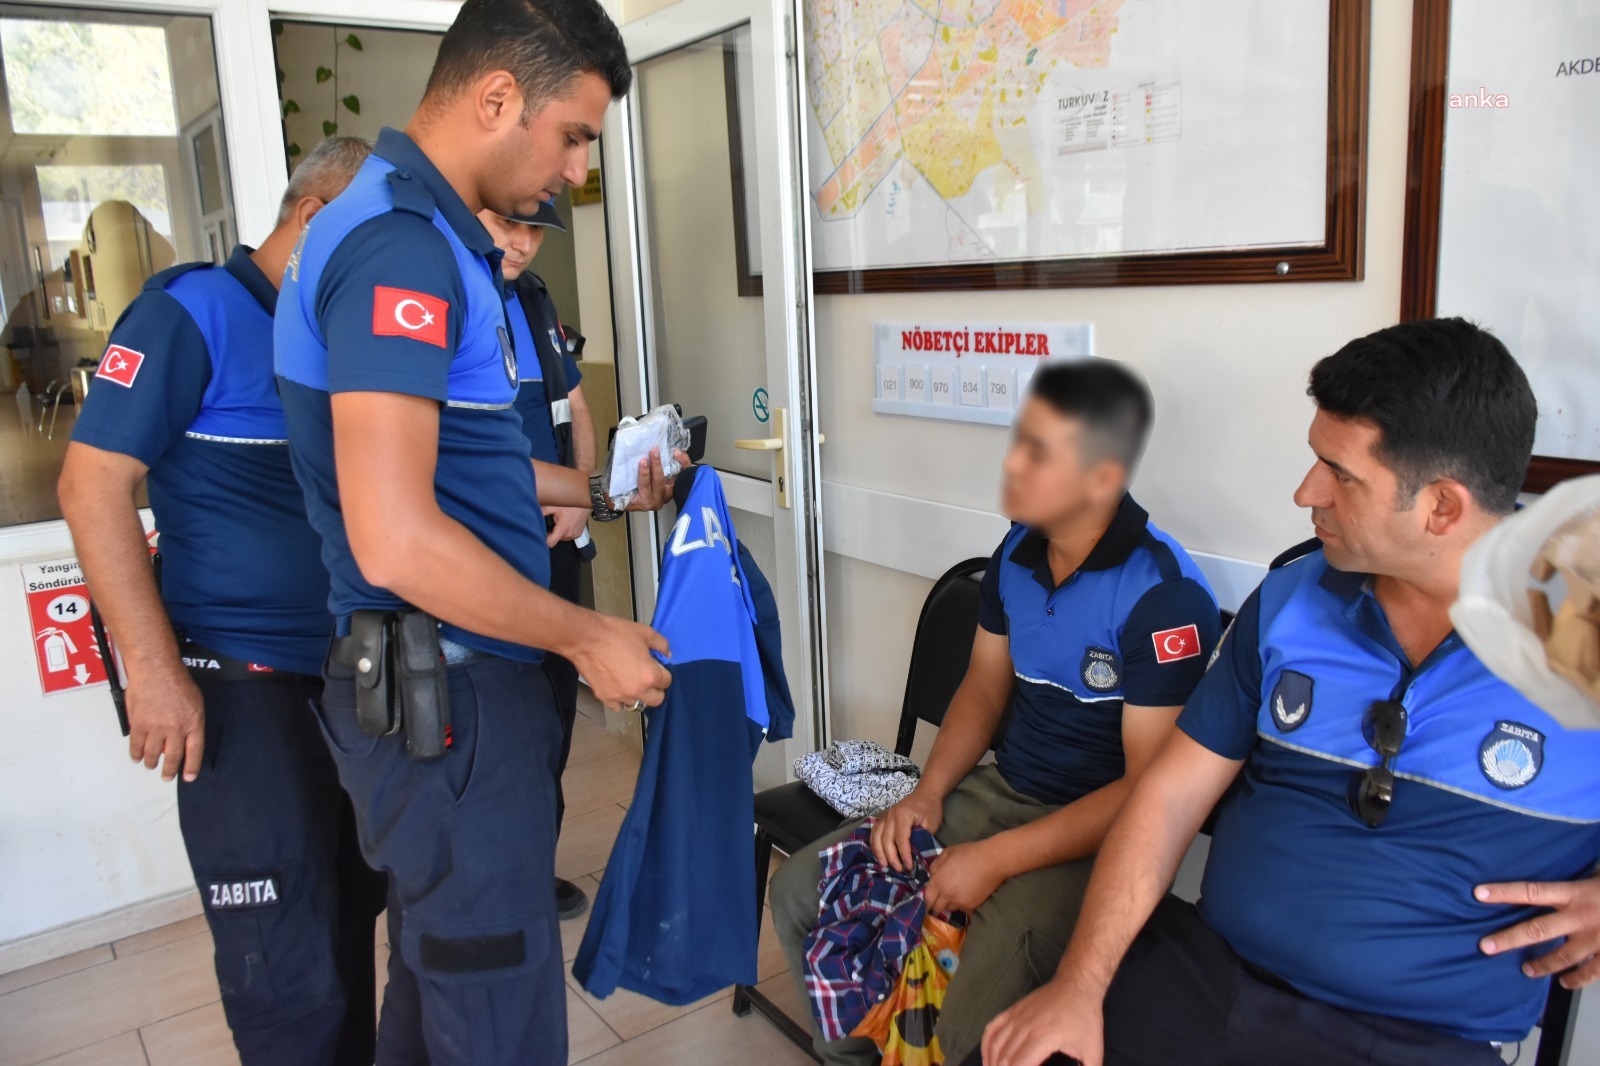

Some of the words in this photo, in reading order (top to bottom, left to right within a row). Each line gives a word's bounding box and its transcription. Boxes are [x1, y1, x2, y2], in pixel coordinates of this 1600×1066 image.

[1555, 57, 1600, 77] AKDE
[902, 326, 969, 358] NÖBETÇİ
[974, 327, 1050, 356] EKİPLER
[883, 379, 897, 390] 021
[909, 379, 924, 390] 900
[933, 381, 948, 393] 970
[962, 381, 978, 393] 834
[990, 382, 1007, 395] 790
[29, 575, 87, 591] Söndürüc
[54, 601, 78, 616] 14
[182, 656, 221, 669] BITA
[1088, 650, 1114, 662] ZABITA
[1500, 722, 1539, 743] ZABITA
[209, 879, 278, 906] ZABITA
